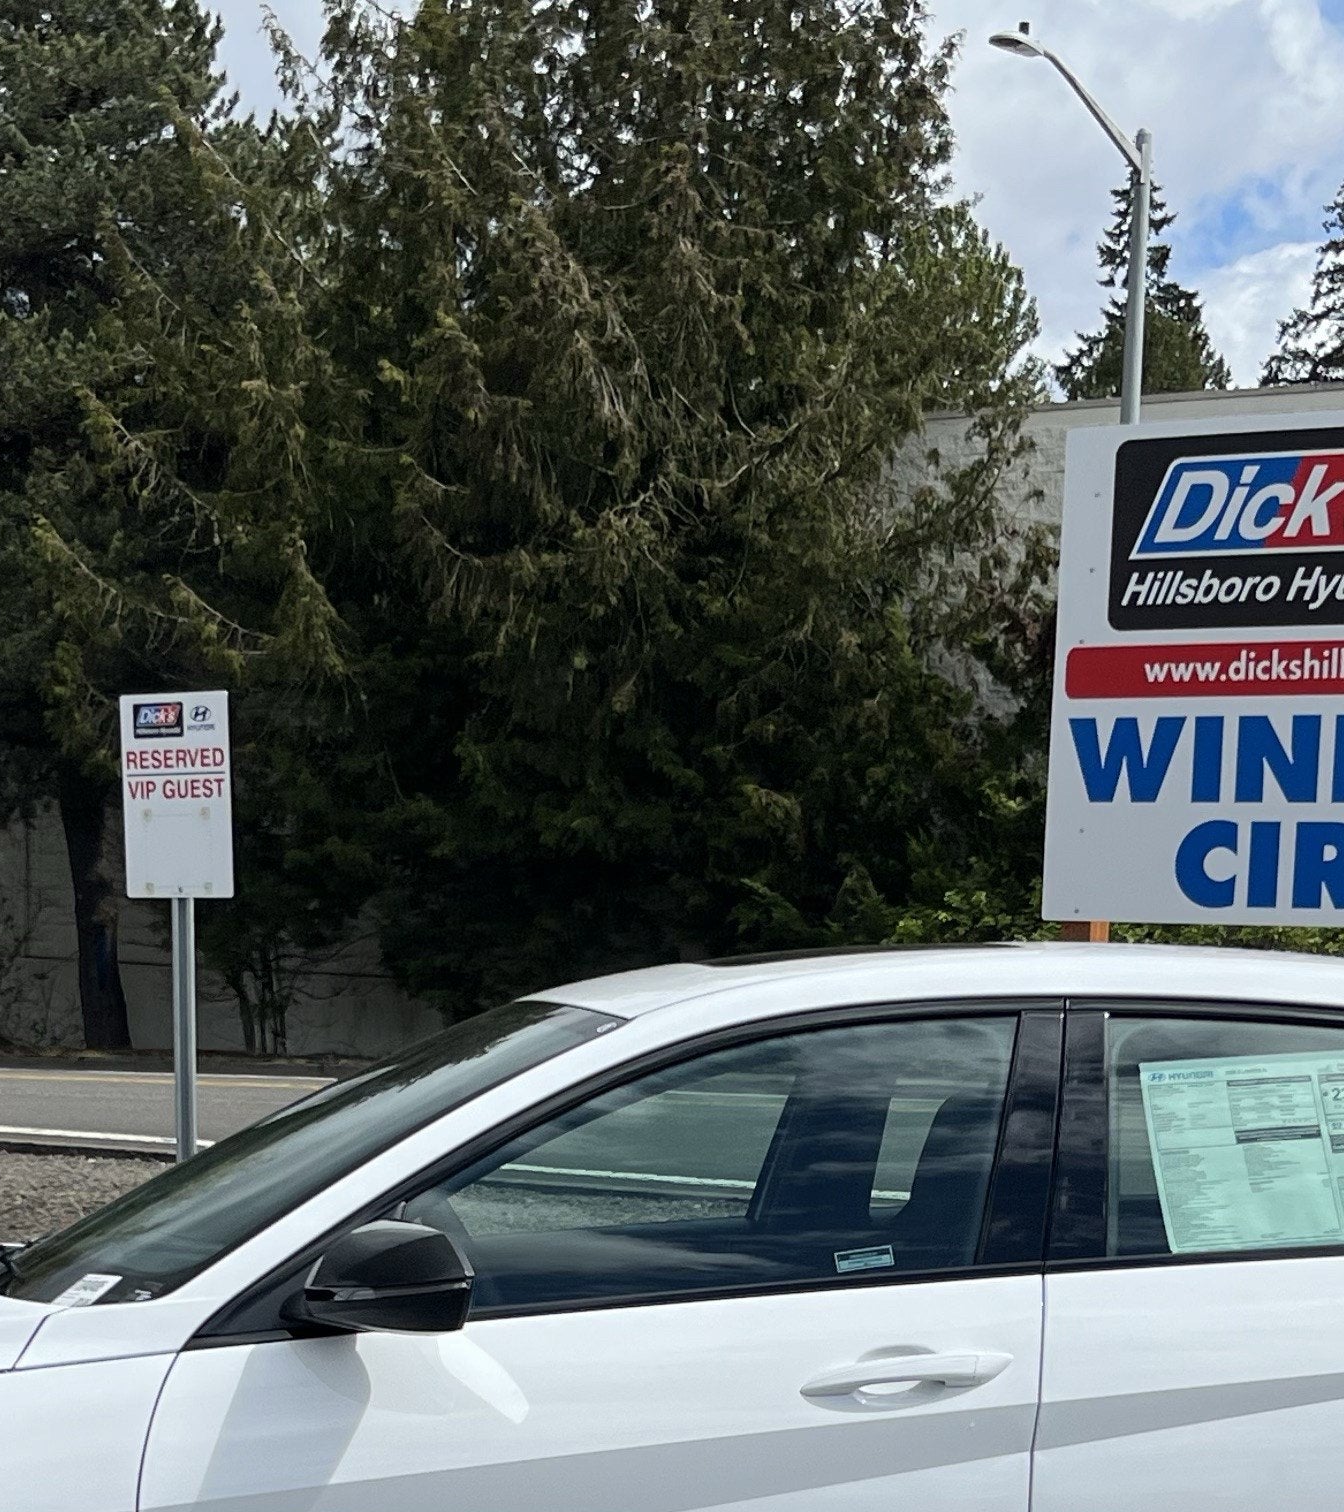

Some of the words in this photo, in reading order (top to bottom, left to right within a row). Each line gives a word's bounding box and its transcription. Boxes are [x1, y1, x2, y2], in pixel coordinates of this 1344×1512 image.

[1120, 568, 1282, 607] Hillsboro
[126, 747, 225, 770] RESERVED
[128, 780, 157, 800] VIP
[162, 778, 225, 800] GUEST
